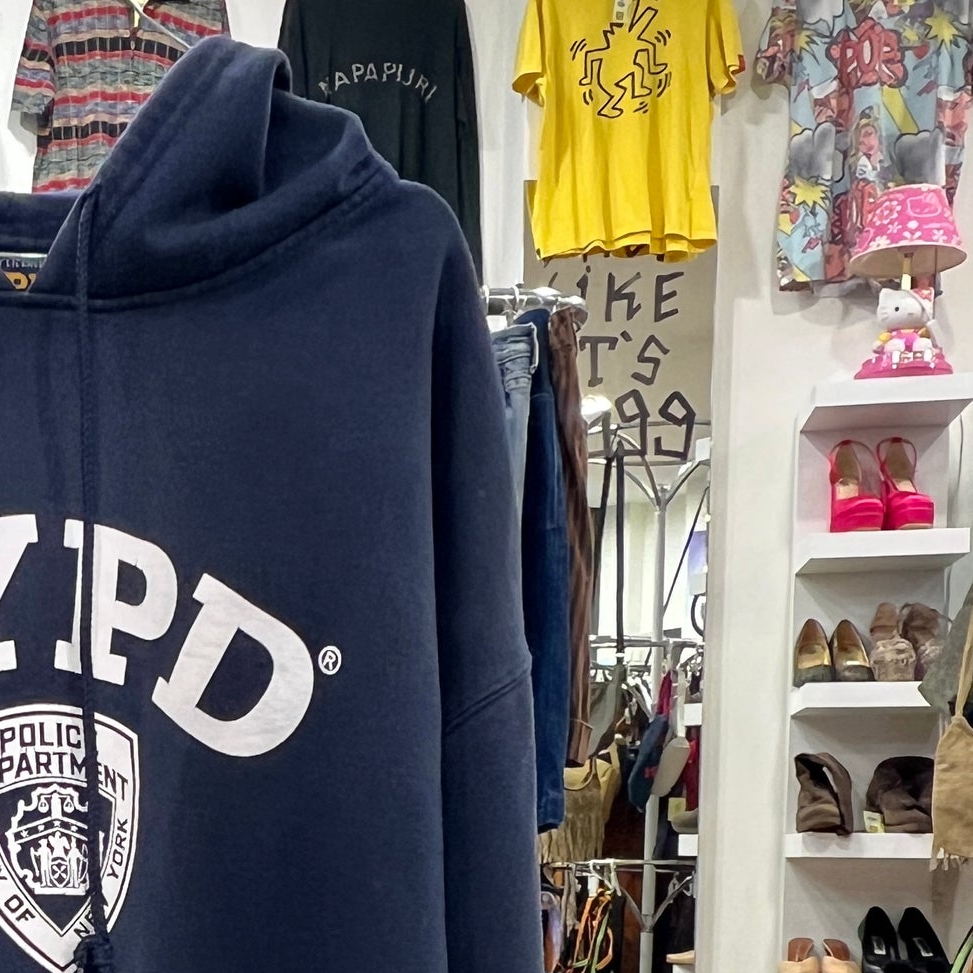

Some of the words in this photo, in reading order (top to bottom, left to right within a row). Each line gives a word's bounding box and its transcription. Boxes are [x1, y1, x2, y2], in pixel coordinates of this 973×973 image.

[0, 721, 85, 758] POLIC
[106, 818, 128, 880] YORK
[3, 893, 36, 922] OF
